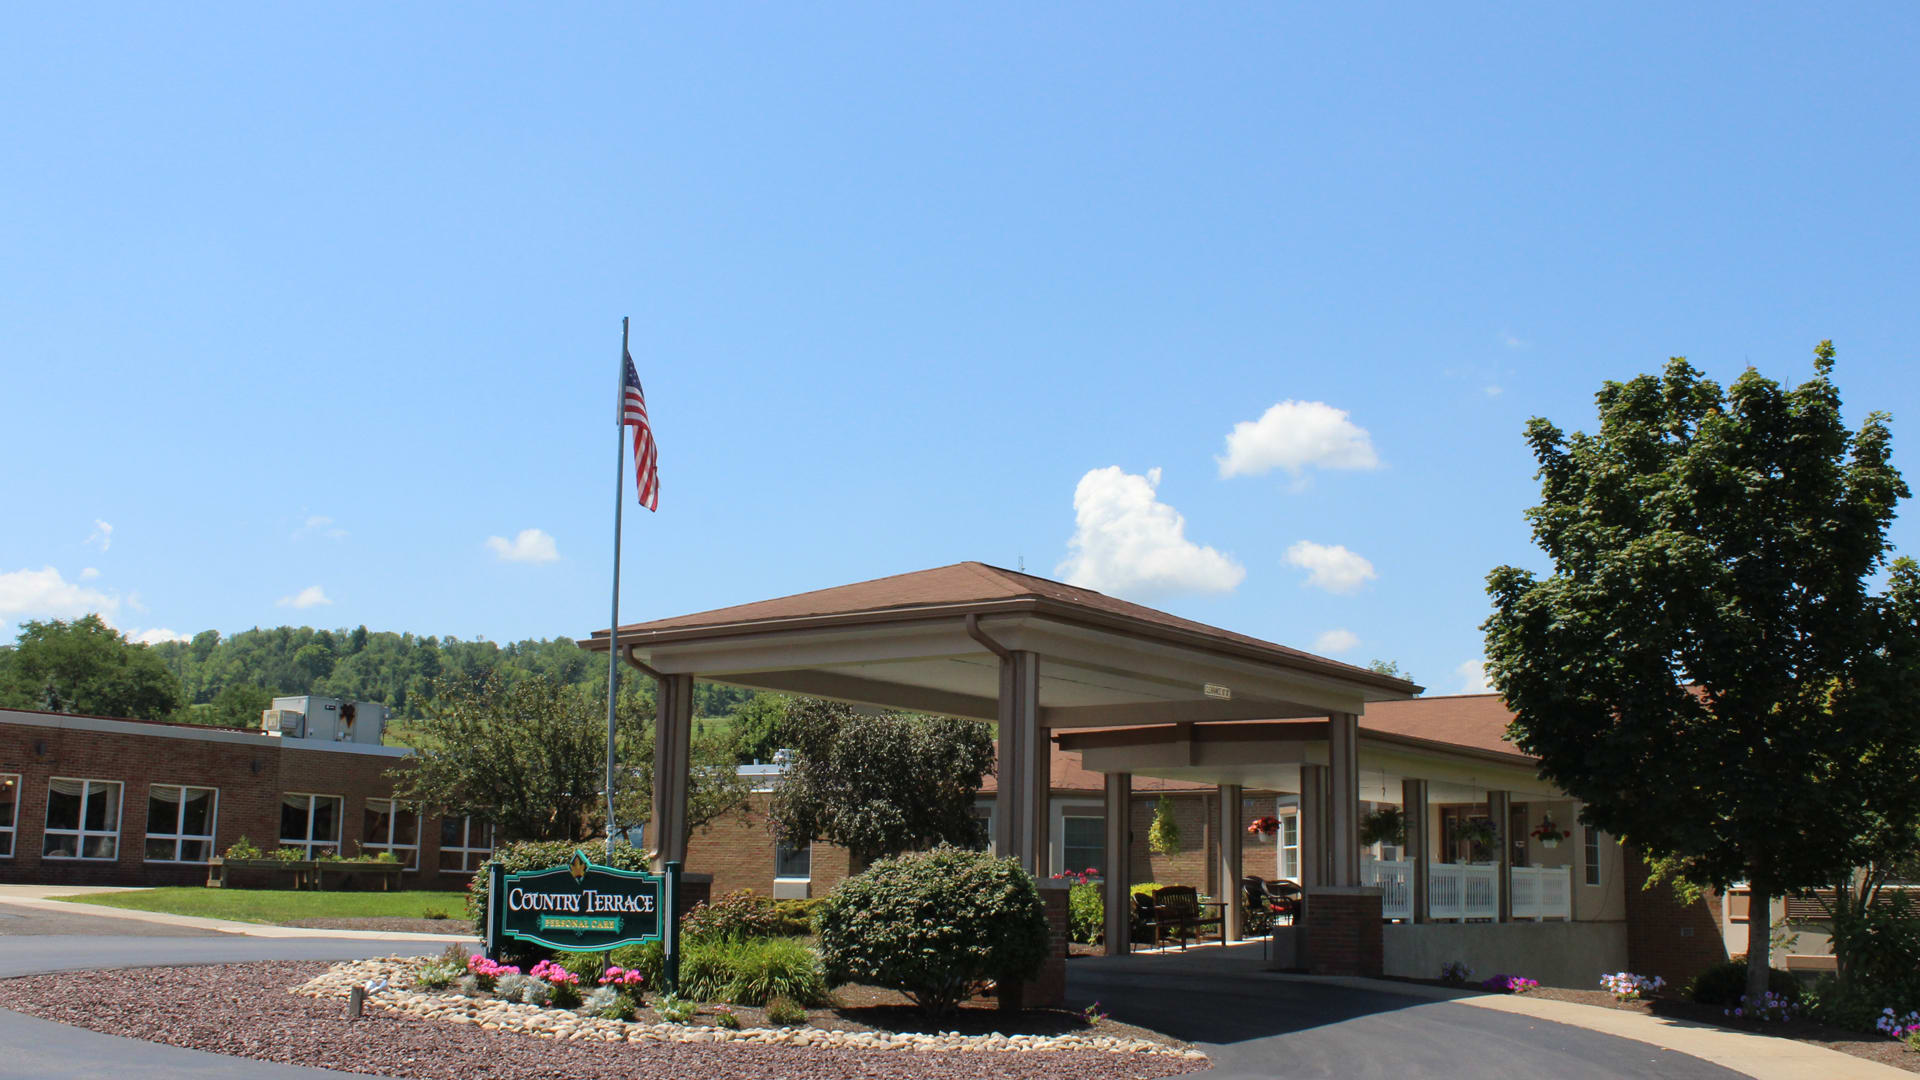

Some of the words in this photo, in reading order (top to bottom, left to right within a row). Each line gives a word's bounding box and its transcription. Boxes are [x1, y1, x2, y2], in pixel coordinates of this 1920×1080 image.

[509, 888, 581, 912] COUNTRY
[582, 889, 655, 913] TERRACE
[544, 919, 589, 929] PERSONAL
[591, 919, 615, 929] CARE
